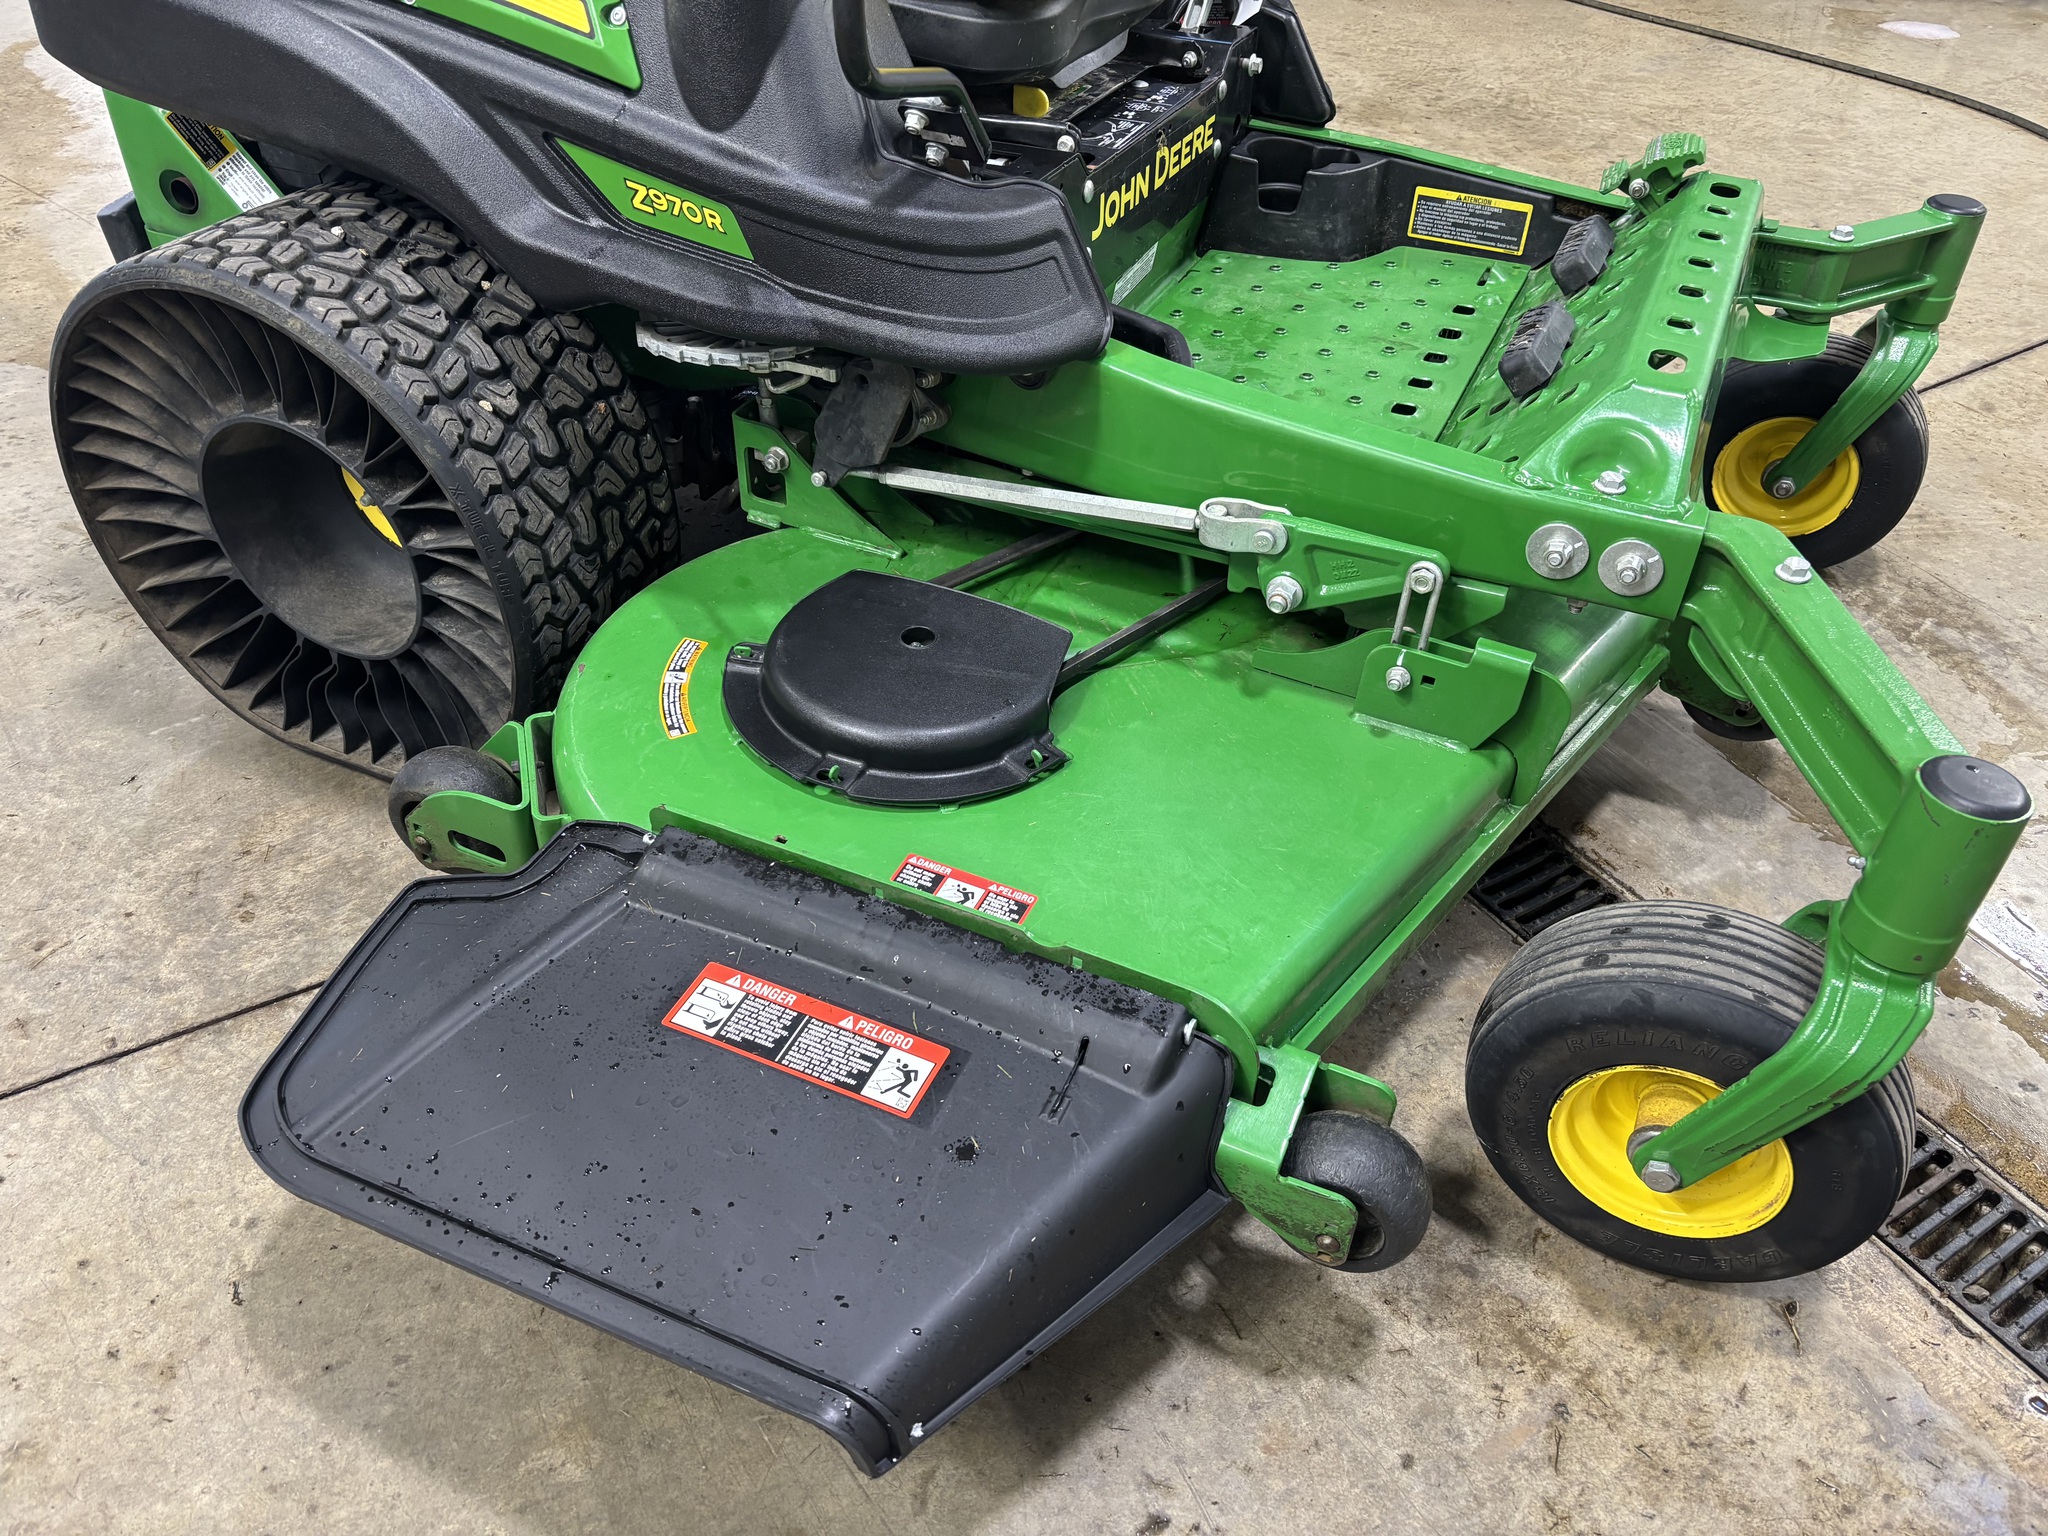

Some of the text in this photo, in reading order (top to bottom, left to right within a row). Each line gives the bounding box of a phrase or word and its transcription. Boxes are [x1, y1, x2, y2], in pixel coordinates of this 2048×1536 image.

[1092, 165, 1150, 241] JOHN
[1154, 114, 1216, 190] DEERE
[624, 178, 727, 235] Z970R
[916, 858, 952, 875] DANGER
[996, 886, 1035, 903] PELIGRO
[741, 978, 797, 1006] DANGER
[753, 997, 769, 1006] avoid
[768, 1003, 785, 1011] injury
[743, 1016, 757, 1024] keep
[756, 1021, 774, 1030] others
[747, 1023, 760, 1031] mow
[759, 1028, 780, 1038] without
[769, 1020, 783, 1028] edge
[810, 1018, 823, 1026] Para
[823, 1023, 839, 1032] evitar
[854, 1020, 915, 1050] PELIGRO
[1565, 1030, 1749, 1070] RELIANC
